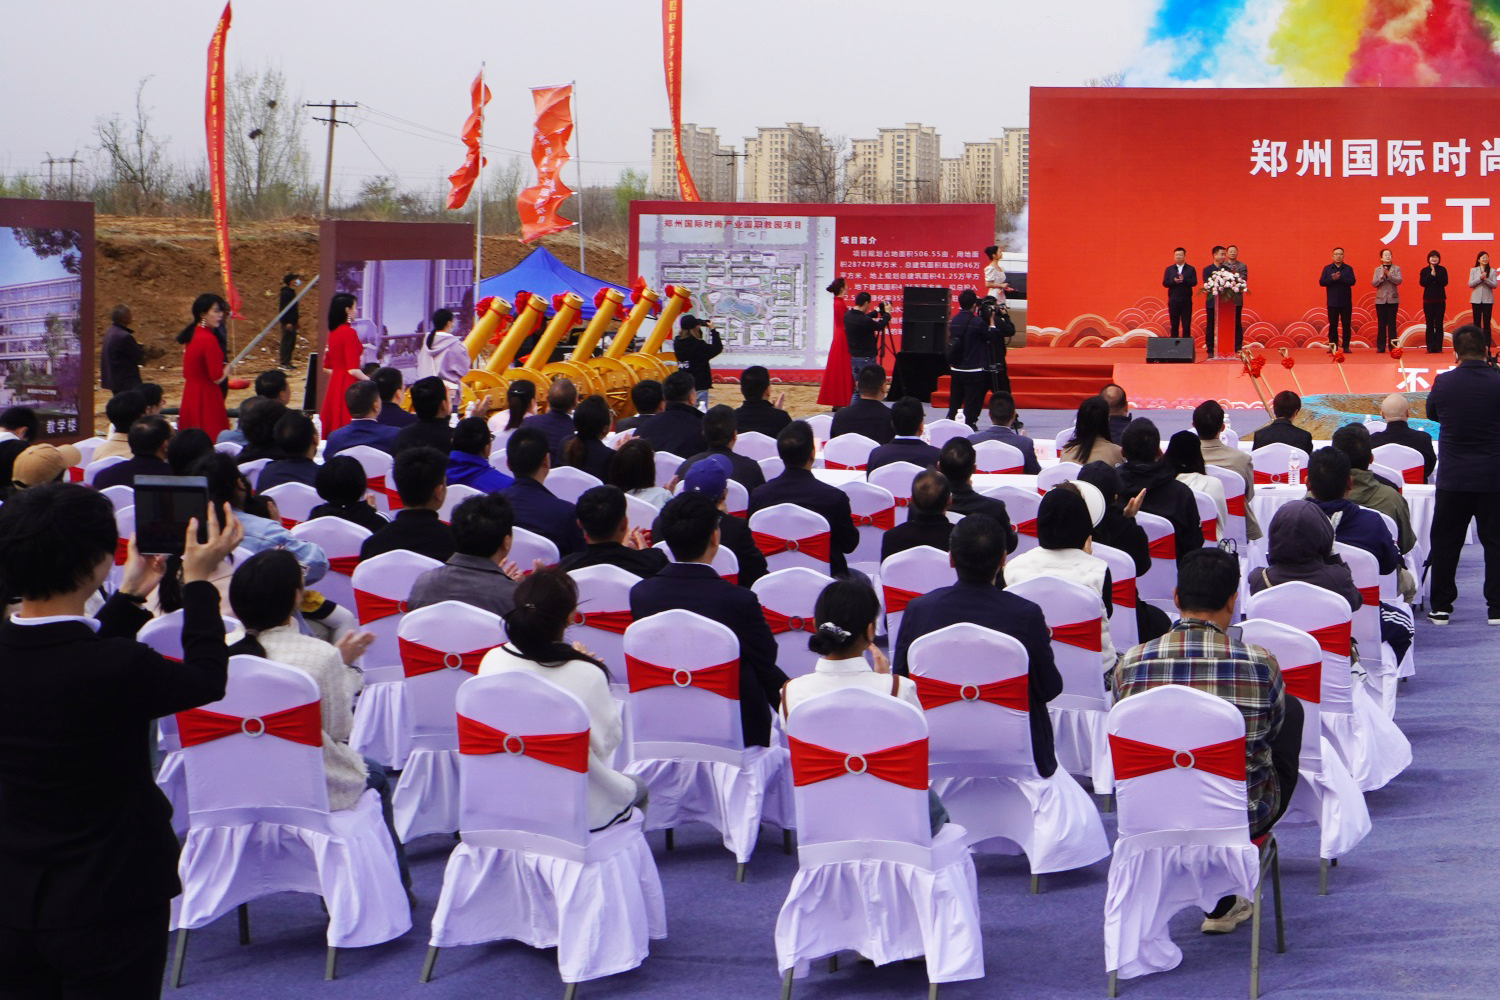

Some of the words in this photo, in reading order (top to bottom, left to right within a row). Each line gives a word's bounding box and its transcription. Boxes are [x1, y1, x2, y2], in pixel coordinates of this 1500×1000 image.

[664, 219, 802, 230] 郑州国际时尚产业园职教园项目
[840, 236, 877, 245] 项目简介
[46, 418, 77, 434] 教学楼
